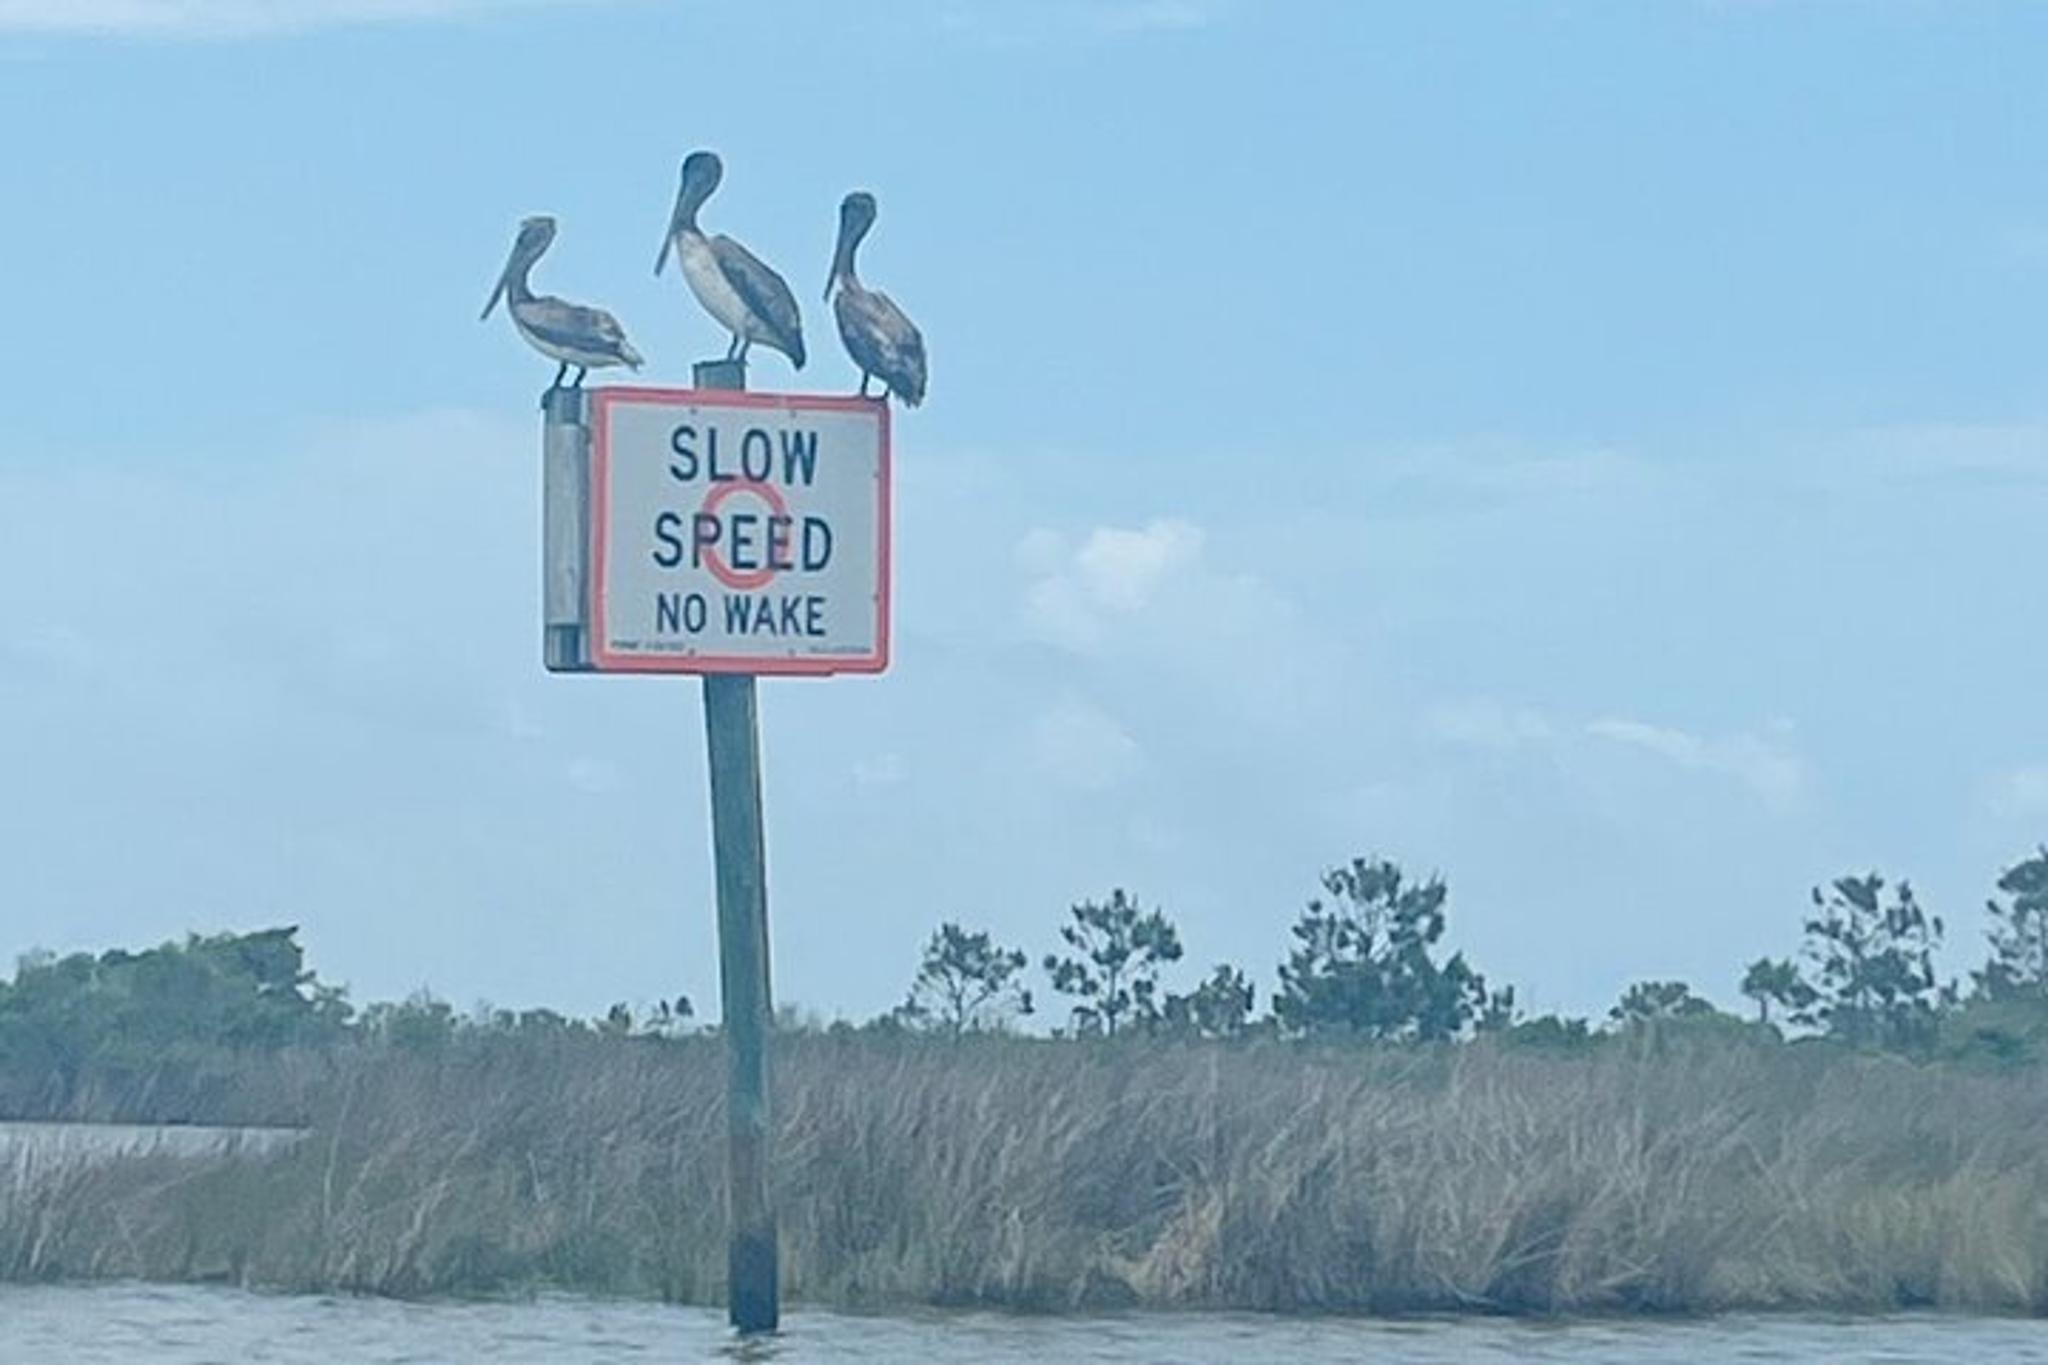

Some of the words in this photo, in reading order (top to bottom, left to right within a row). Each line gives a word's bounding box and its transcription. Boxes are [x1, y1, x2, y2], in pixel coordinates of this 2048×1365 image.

[669, 424, 819, 487] SLOW
[652, 511, 834, 573] SPEED
[656, 592, 708, 635] NO
[723, 594, 828, 638] WAKE
